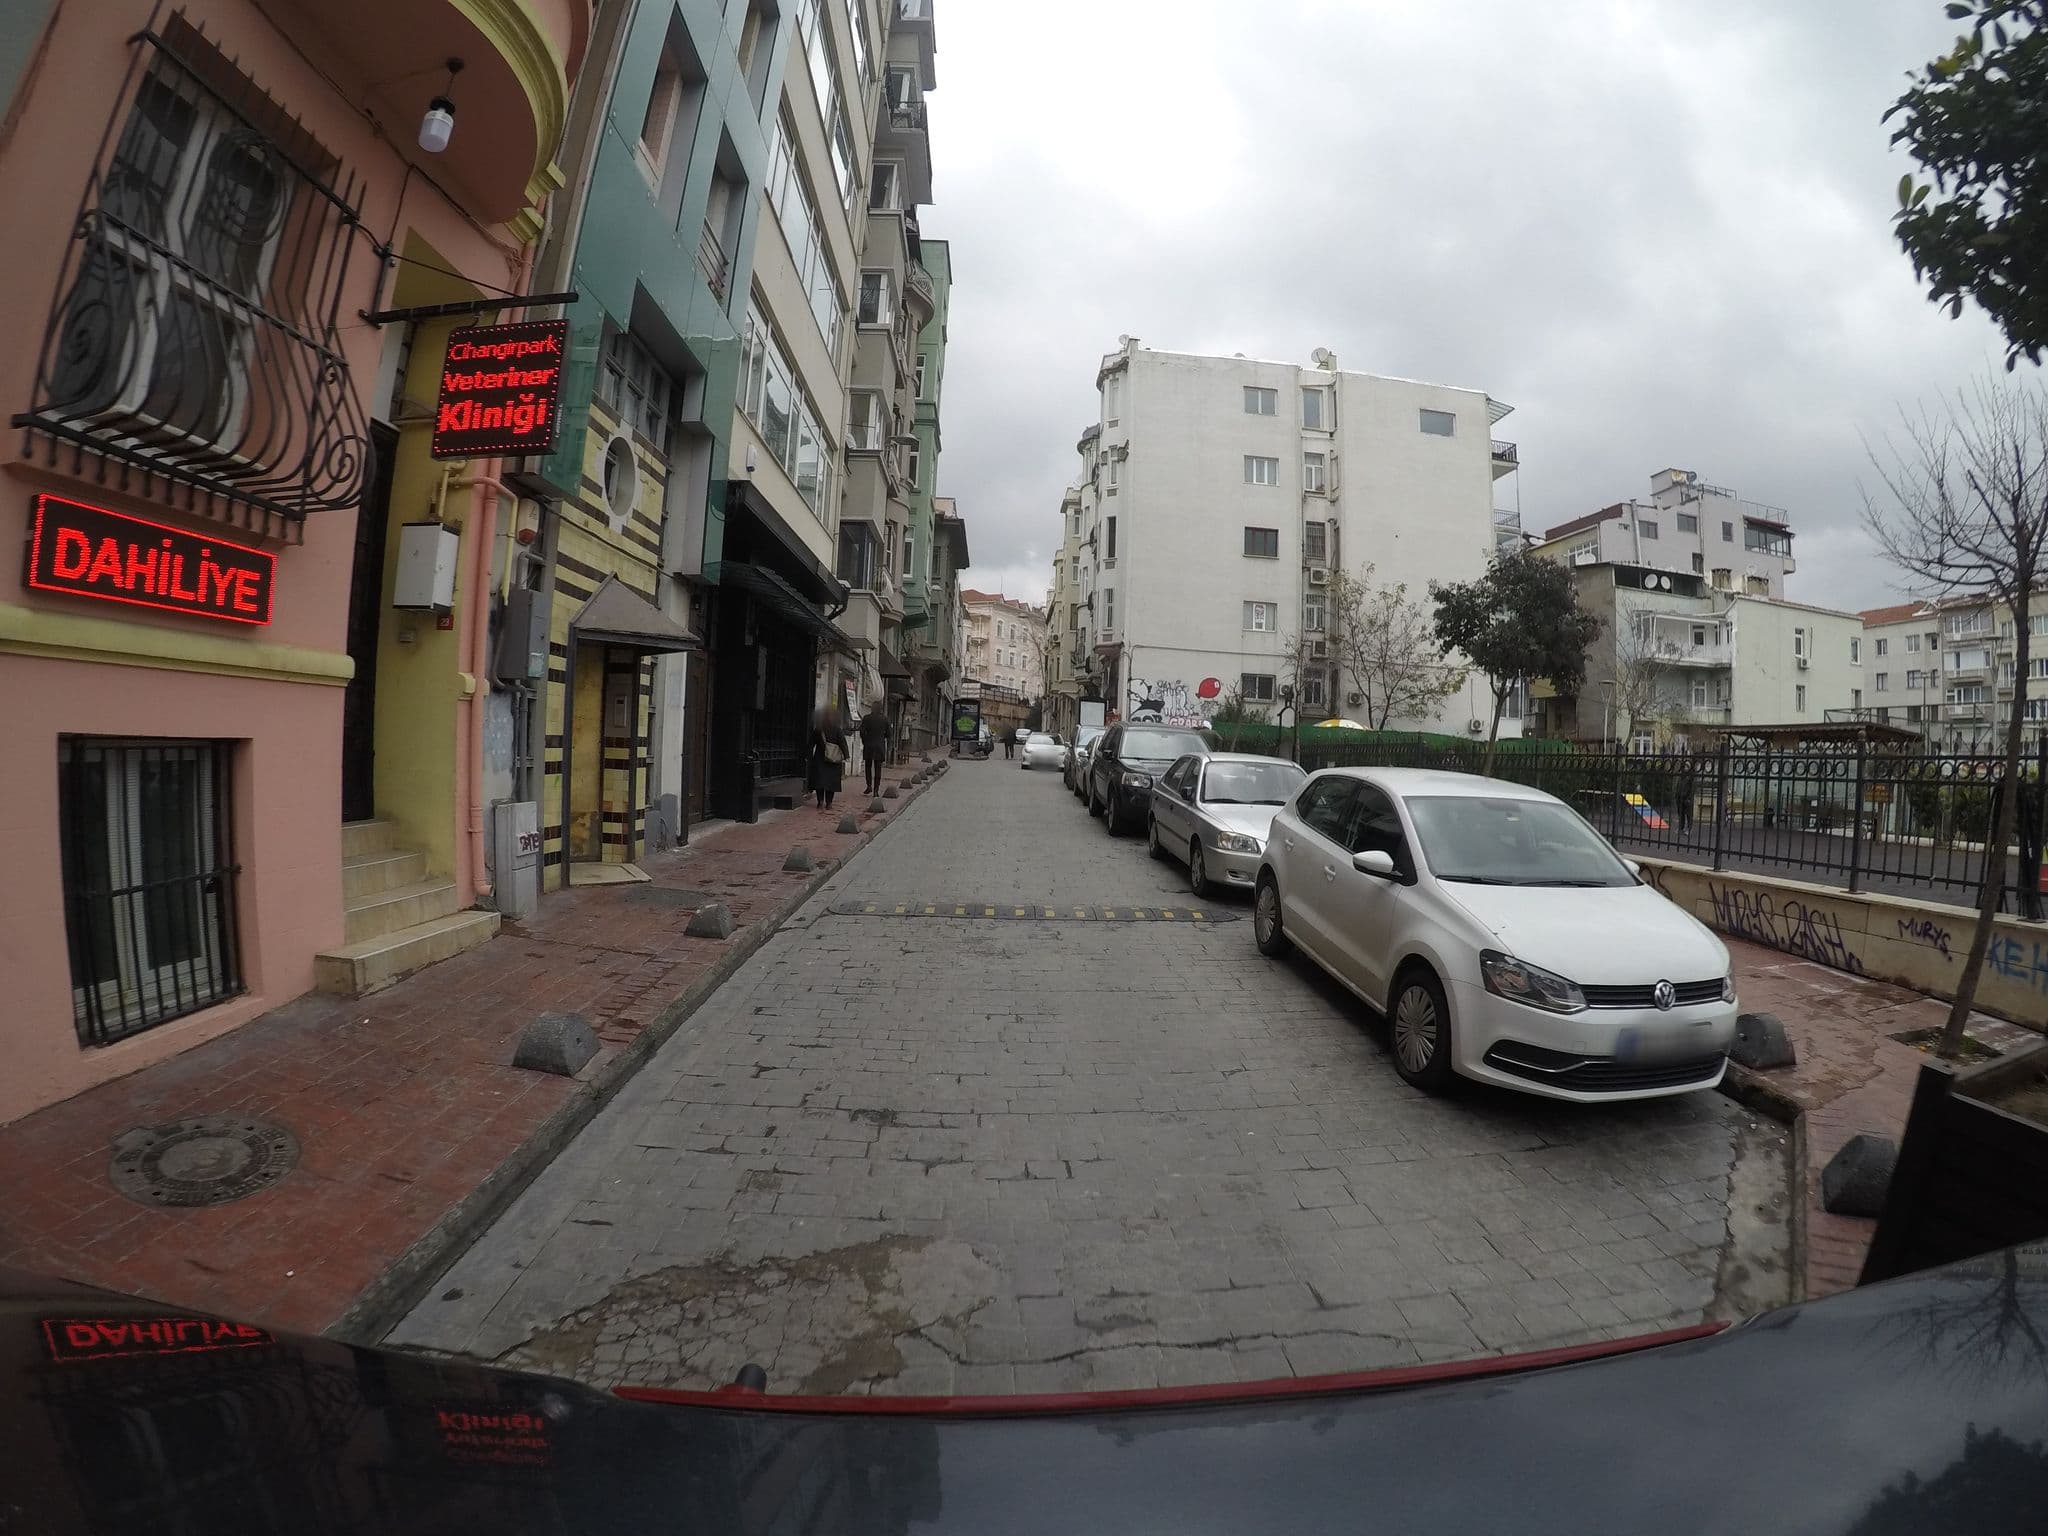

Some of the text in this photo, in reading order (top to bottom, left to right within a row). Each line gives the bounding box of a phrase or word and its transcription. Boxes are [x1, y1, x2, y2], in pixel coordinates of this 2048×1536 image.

[443, 367, 555, 392] Veteriner
[440, 393, 548, 434] Kliniği
[53, 527, 261, 612] DAHİLİYE
